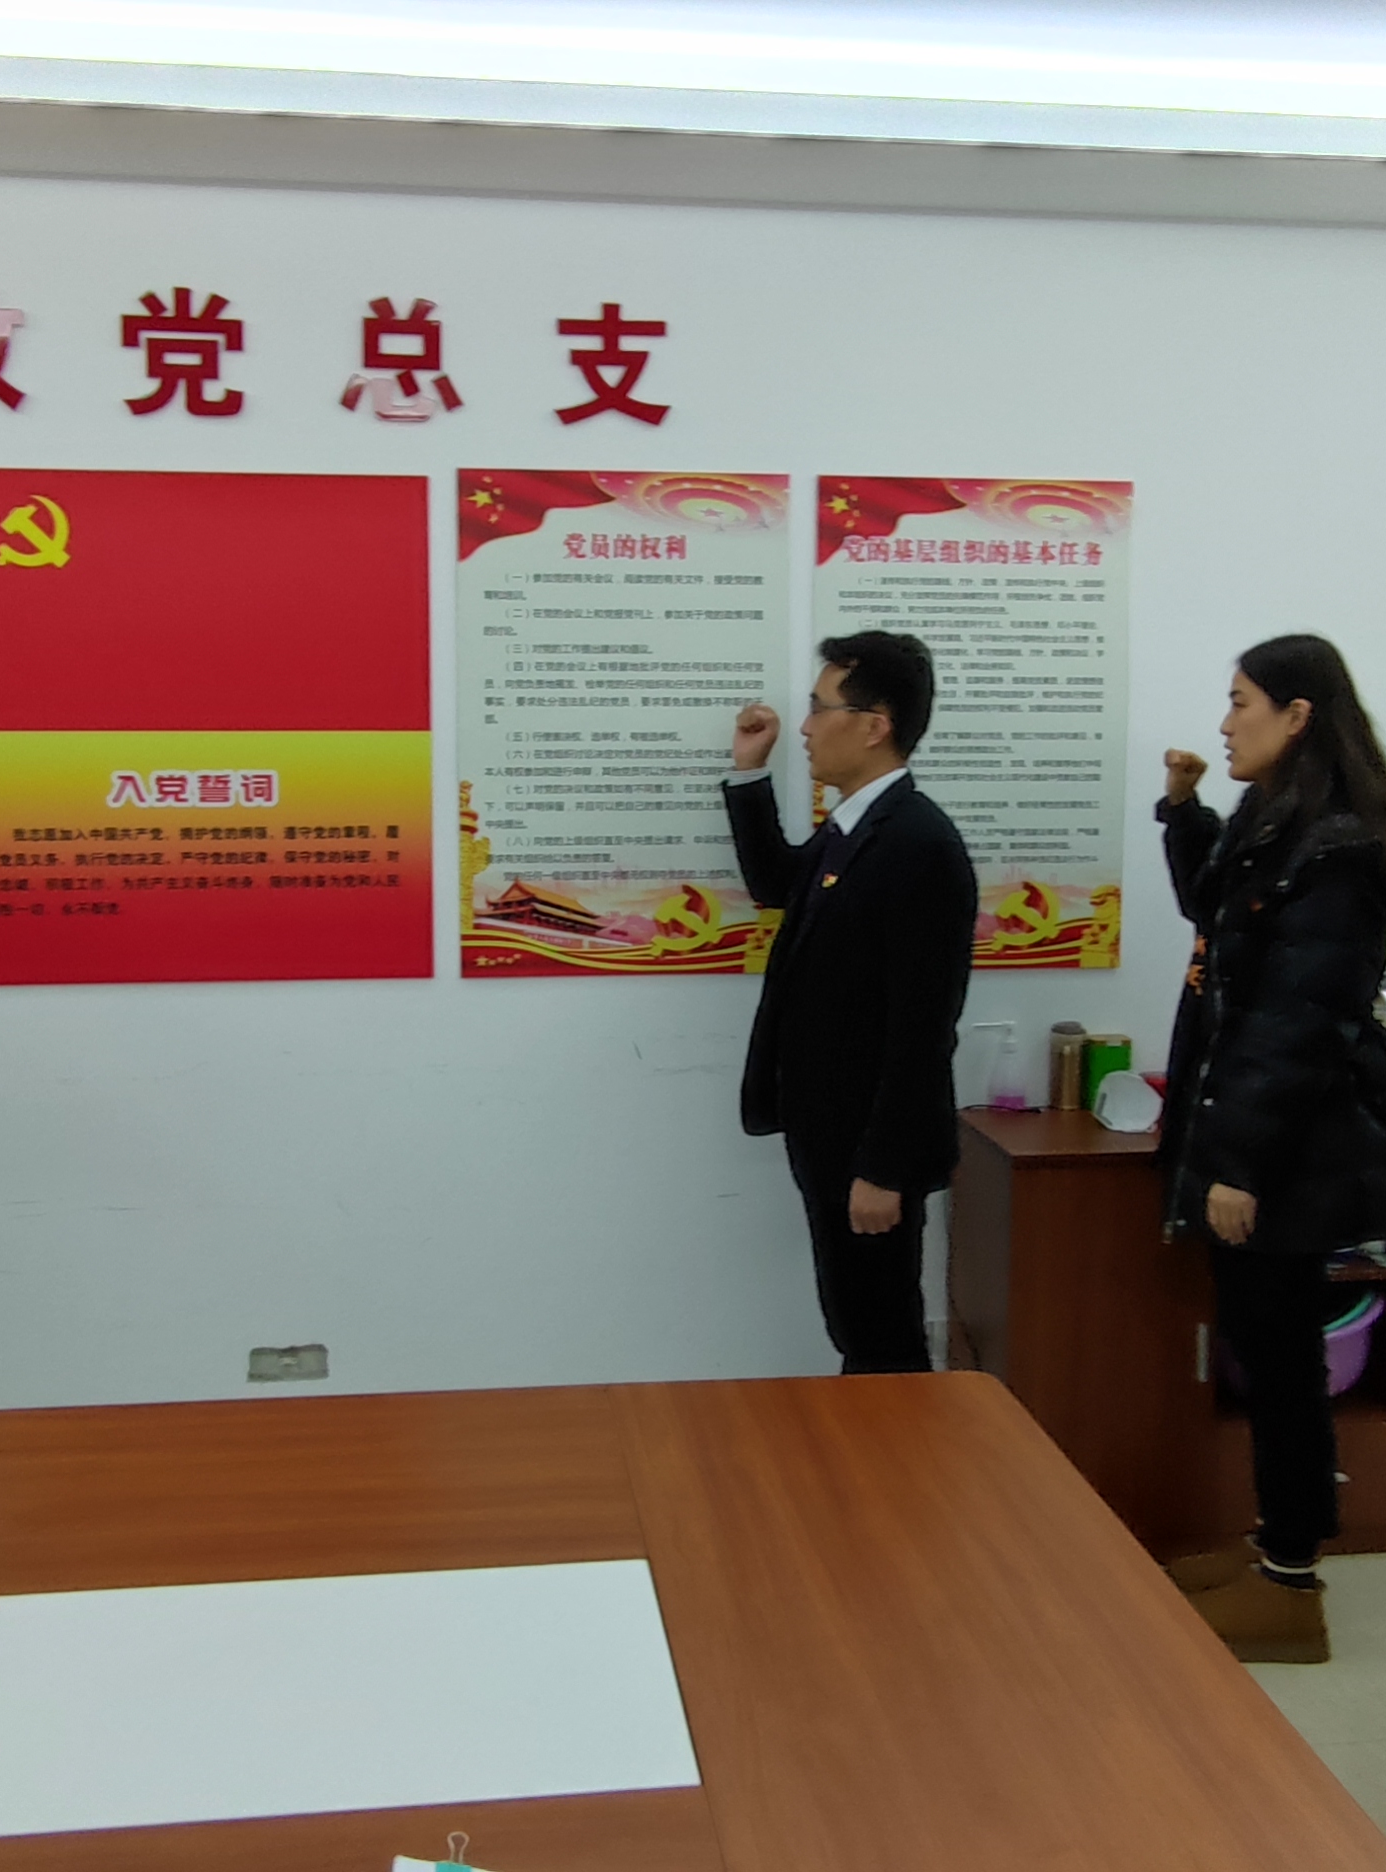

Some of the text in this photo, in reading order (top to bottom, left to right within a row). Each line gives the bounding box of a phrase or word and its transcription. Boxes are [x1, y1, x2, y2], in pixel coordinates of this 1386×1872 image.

[563, 532, 687, 560] 党员的权利
[844, 535, 1103, 566] 党的基层组织的基本任务
[110, 773, 277, 805] 入党誓词
